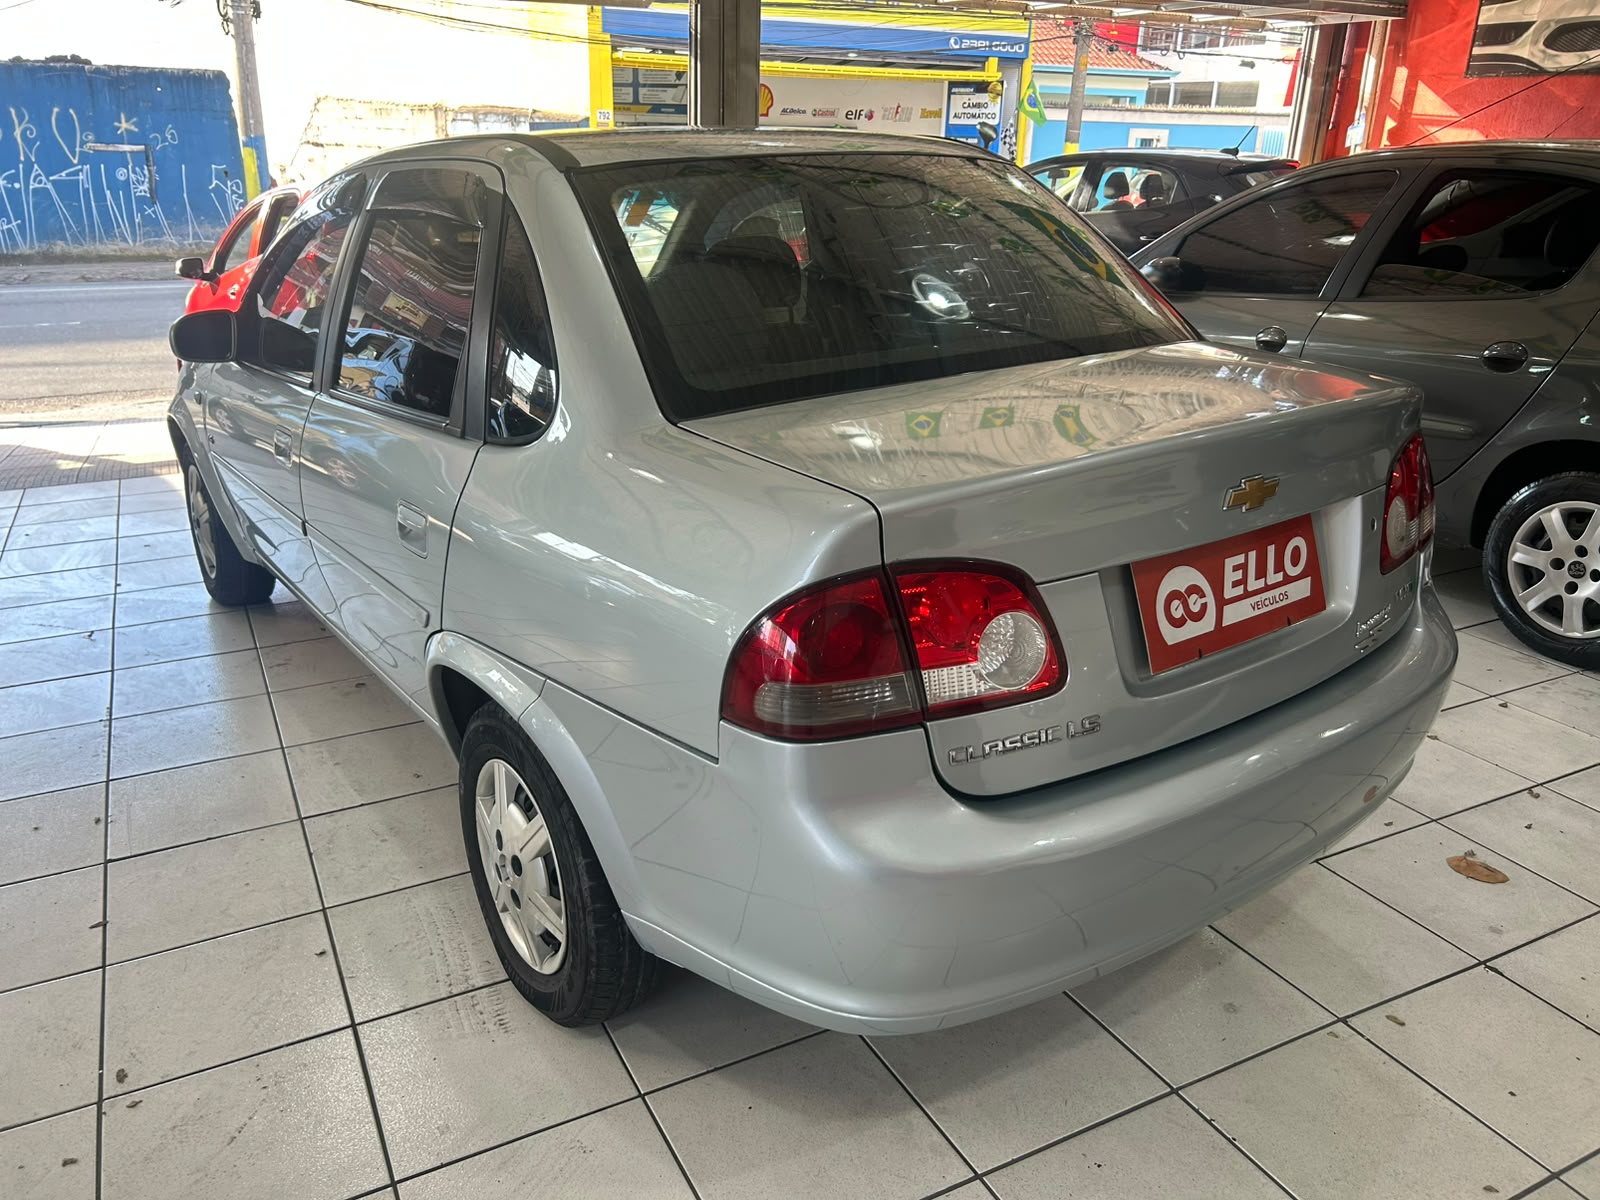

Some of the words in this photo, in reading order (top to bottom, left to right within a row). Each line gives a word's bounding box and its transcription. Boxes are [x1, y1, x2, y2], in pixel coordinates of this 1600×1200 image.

[961, 97, 989, 109] CÂMBIO
[598, 111, 611, 121] 792
[845, 109, 864, 120] elf
[952, 109, 997, 120] AUTOMÁTICO
[1223, 536, 1307, 600] ELLO
[1250, 590, 1289, 612] VEÍCULOS
[948, 725, 1062, 766] CLASSIC
[1066, 713, 1101, 739] LS
